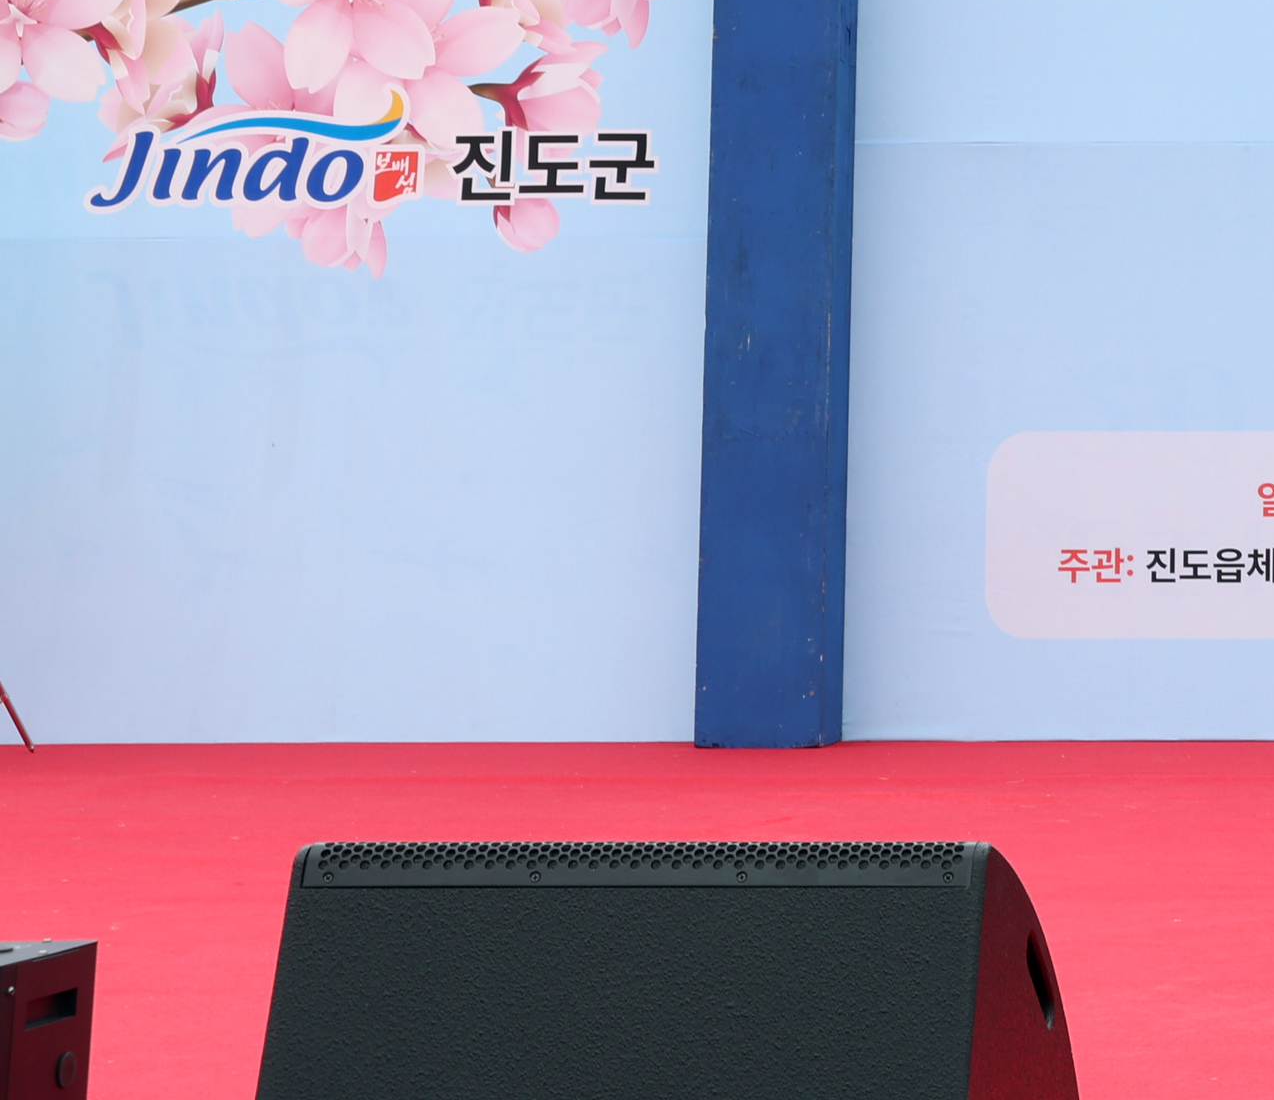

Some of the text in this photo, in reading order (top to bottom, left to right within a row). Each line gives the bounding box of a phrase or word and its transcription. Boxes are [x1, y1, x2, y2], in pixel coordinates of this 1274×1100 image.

[90, 129, 366, 208] Jindo
[452, 130, 655, 201] 진도군
[1057, 546, 1136, 584] 주관:
